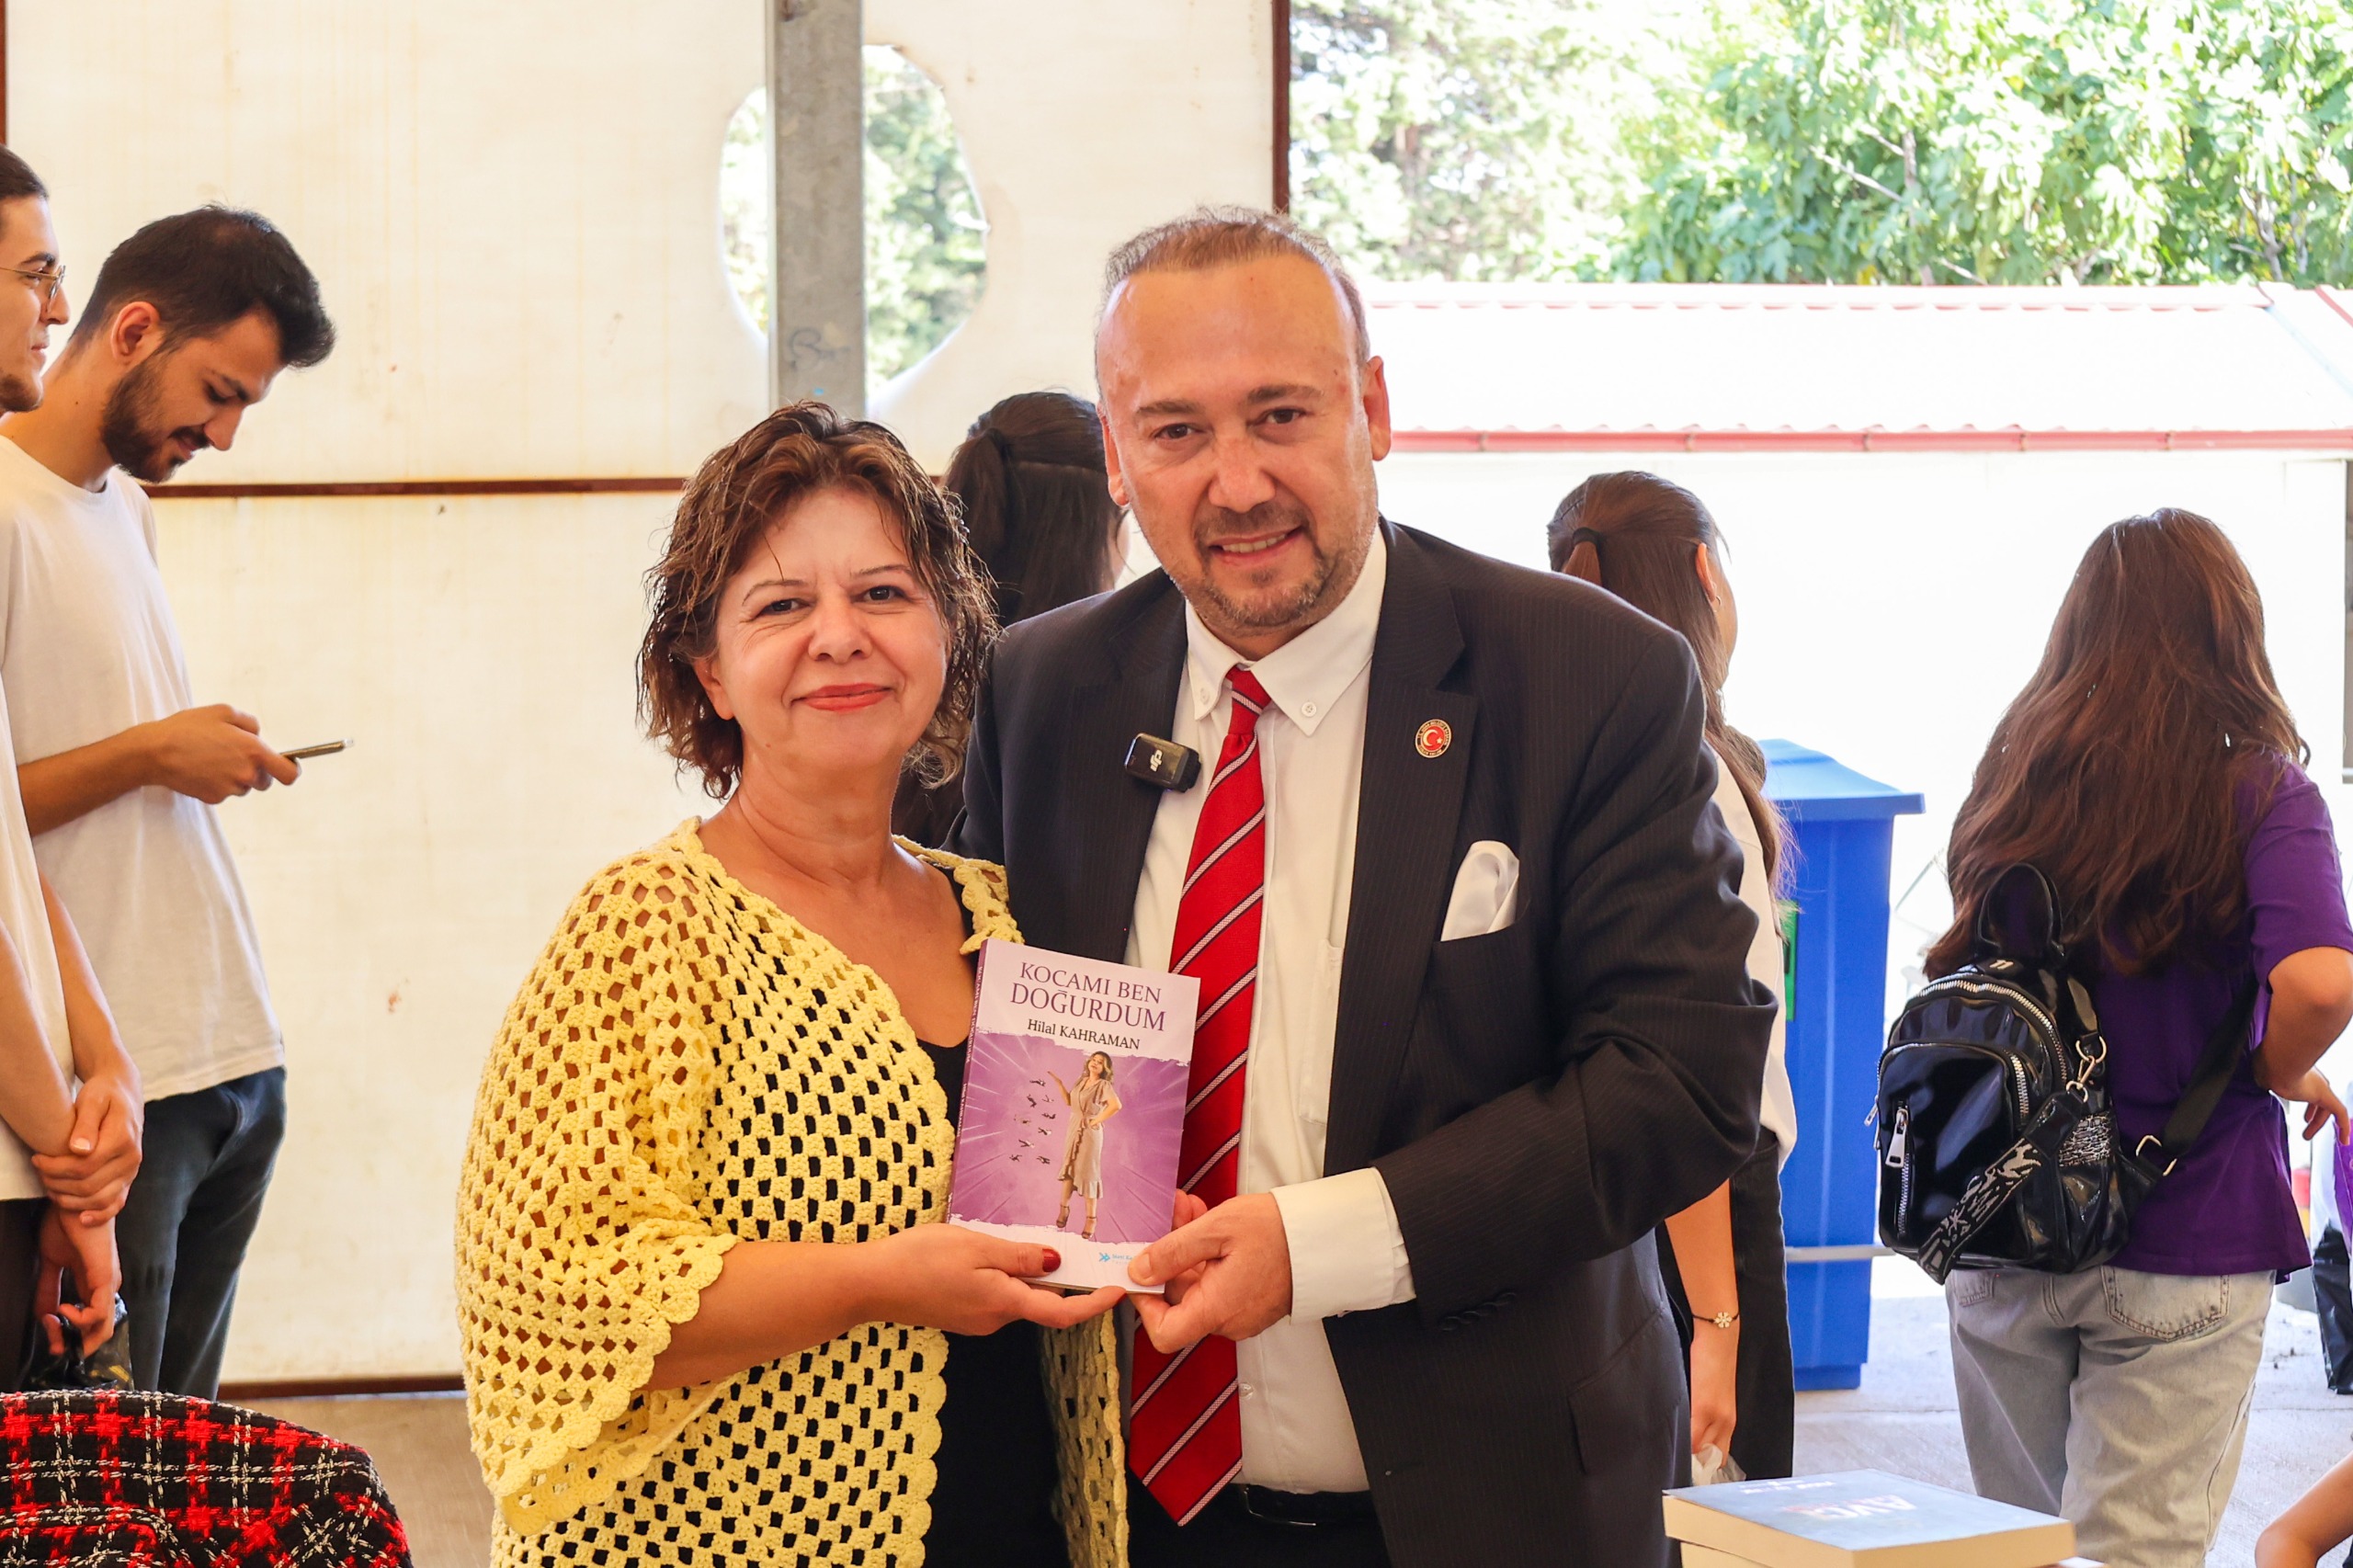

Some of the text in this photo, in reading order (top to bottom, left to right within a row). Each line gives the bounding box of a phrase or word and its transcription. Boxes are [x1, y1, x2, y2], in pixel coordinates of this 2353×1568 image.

[1019, 961, 1162, 1004] KOCAMI BEN
[1010, 983, 1165, 1031] DOĞURDUM
[1027, 1018, 1140, 1050] Hilal KAHRAMAN
